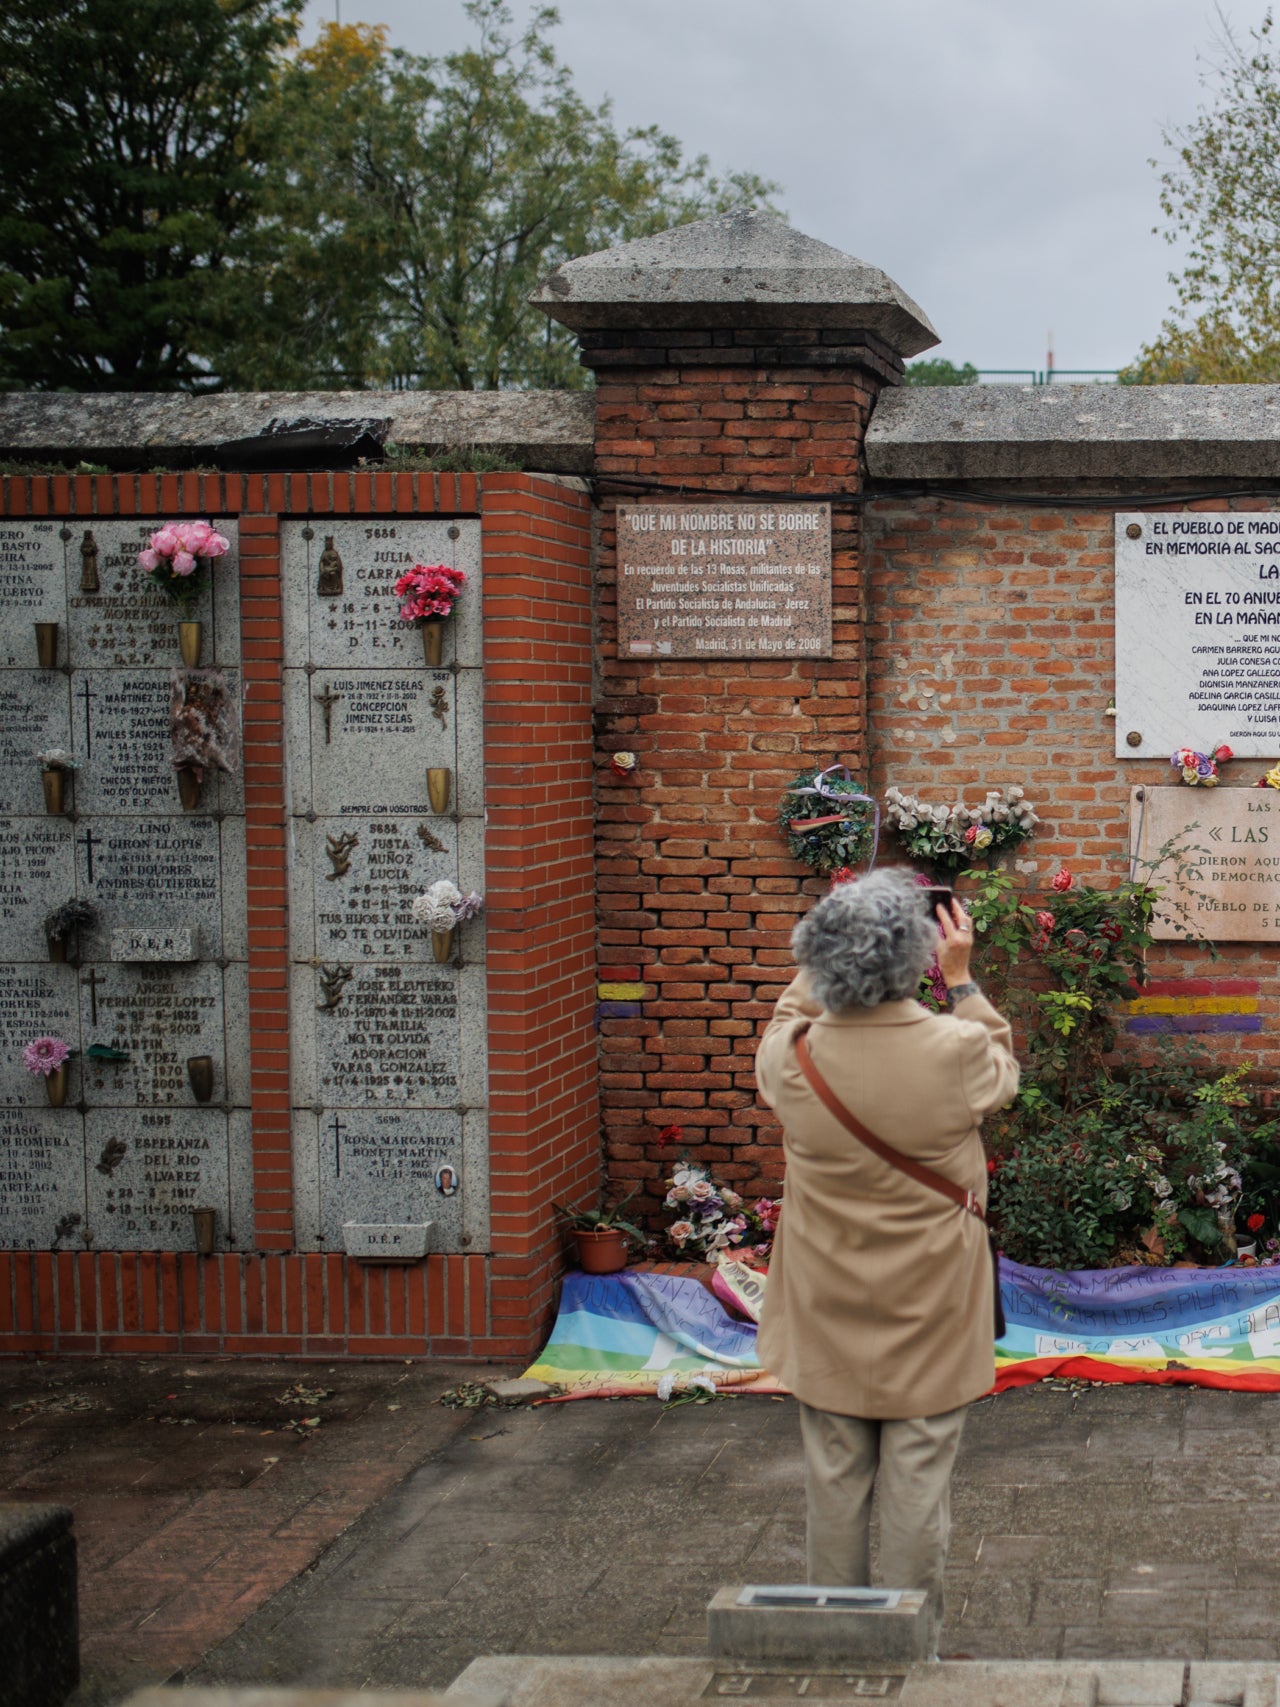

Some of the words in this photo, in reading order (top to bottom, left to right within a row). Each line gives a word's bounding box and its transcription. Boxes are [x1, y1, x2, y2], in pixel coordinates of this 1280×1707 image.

[660, 515, 676, 530] MI
[680, 514, 733, 530] NOMBRE
[738, 514, 755, 530] NO
[760, 513, 775, 530] SE
[779, 513, 819, 530] BORRE
[1153, 522, 1169, 535] EL
[1173, 522, 1224, 534] PUEBLO
[1228, 522, 1244, 534] DE
[672, 539, 687, 555] DE
[691, 540, 706, 555] LA
[1146, 542, 1163, 555] EN
[1166, 542, 1231, 555] MEMORIA
[1234, 542, 1251, 554] AL
[373, 551, 413, 563] JULIA
[625, 564, 634, 575] En
[637, 564, 675, 575] recuerdo
[678, 564, 688, 575] de
[691, 564, 703, 575] las
[707, 564, 717, 574] 13
[720, 563, 748, 576] Rosas,
[750, 563, 793, 575] militantes
[795, 563, 806, 575] de
[808, 563, 821, 575] las
[1185, 592, 1202, 604] EN
[1206, 592, 1221, 604] EL
[1225, 592, 1240, 604] 70
[1195, 612, 1212, 625] EN
[1216, 612, 1233, 625] LA
[696, 638, 728, 651] Madrid,
[731, 638, 742, 650] 31
[745, 638, 756, 650] de
[758, 638, 783, 652] Mayo
[785, 638, 796, 650] de
[797, 638, 821, 650] 2008
[1192, 646, 1224, 654] CARMEN
[1226, 646, 1262, 654] BARRERO
[333, 681, 354, 690] LUIS
[395, 681, 423, 690] SELAS
[350, 702, 408, 712] CONCEPCION
[345, 714, 382, 724] JIMENEZ
[384, 714, 413, 723] SELAS
[341, 805, 371, 813] SIEMPRE
[372, 805, 388, 813] CON
[389, 805, 428, 813] VOSOTROS
[1248, 803, 1271, 812] LAS
[139, 824, 171, 834] LINO
[155, 839, 203, 849] LLOPIS
[371, 839, 410, 849] JUSTA
[367, 851, 414, 864] MUÑOZ
[1199, 856, 1247, 866] DIERON
[1197, 901, 1247, 912] PUEBLO
[1253, 903, 1269, 912] DE
[329, 929, 347, 939] NO
[352, 929, 368, 939] TE
[373, 929, 428, 939] OLVIDAN
[331, 1062, 372, 1073] VARAS
[379, 1062, 447, 1073] GONZALEZ
[135, 1138, 210, 1149] ESPERANZA
[344, 1136, 376, 1145] ROSA
[381, 1136, 455, 1146] MARGARITA
[352, 1148, 394, 1157] BONET
